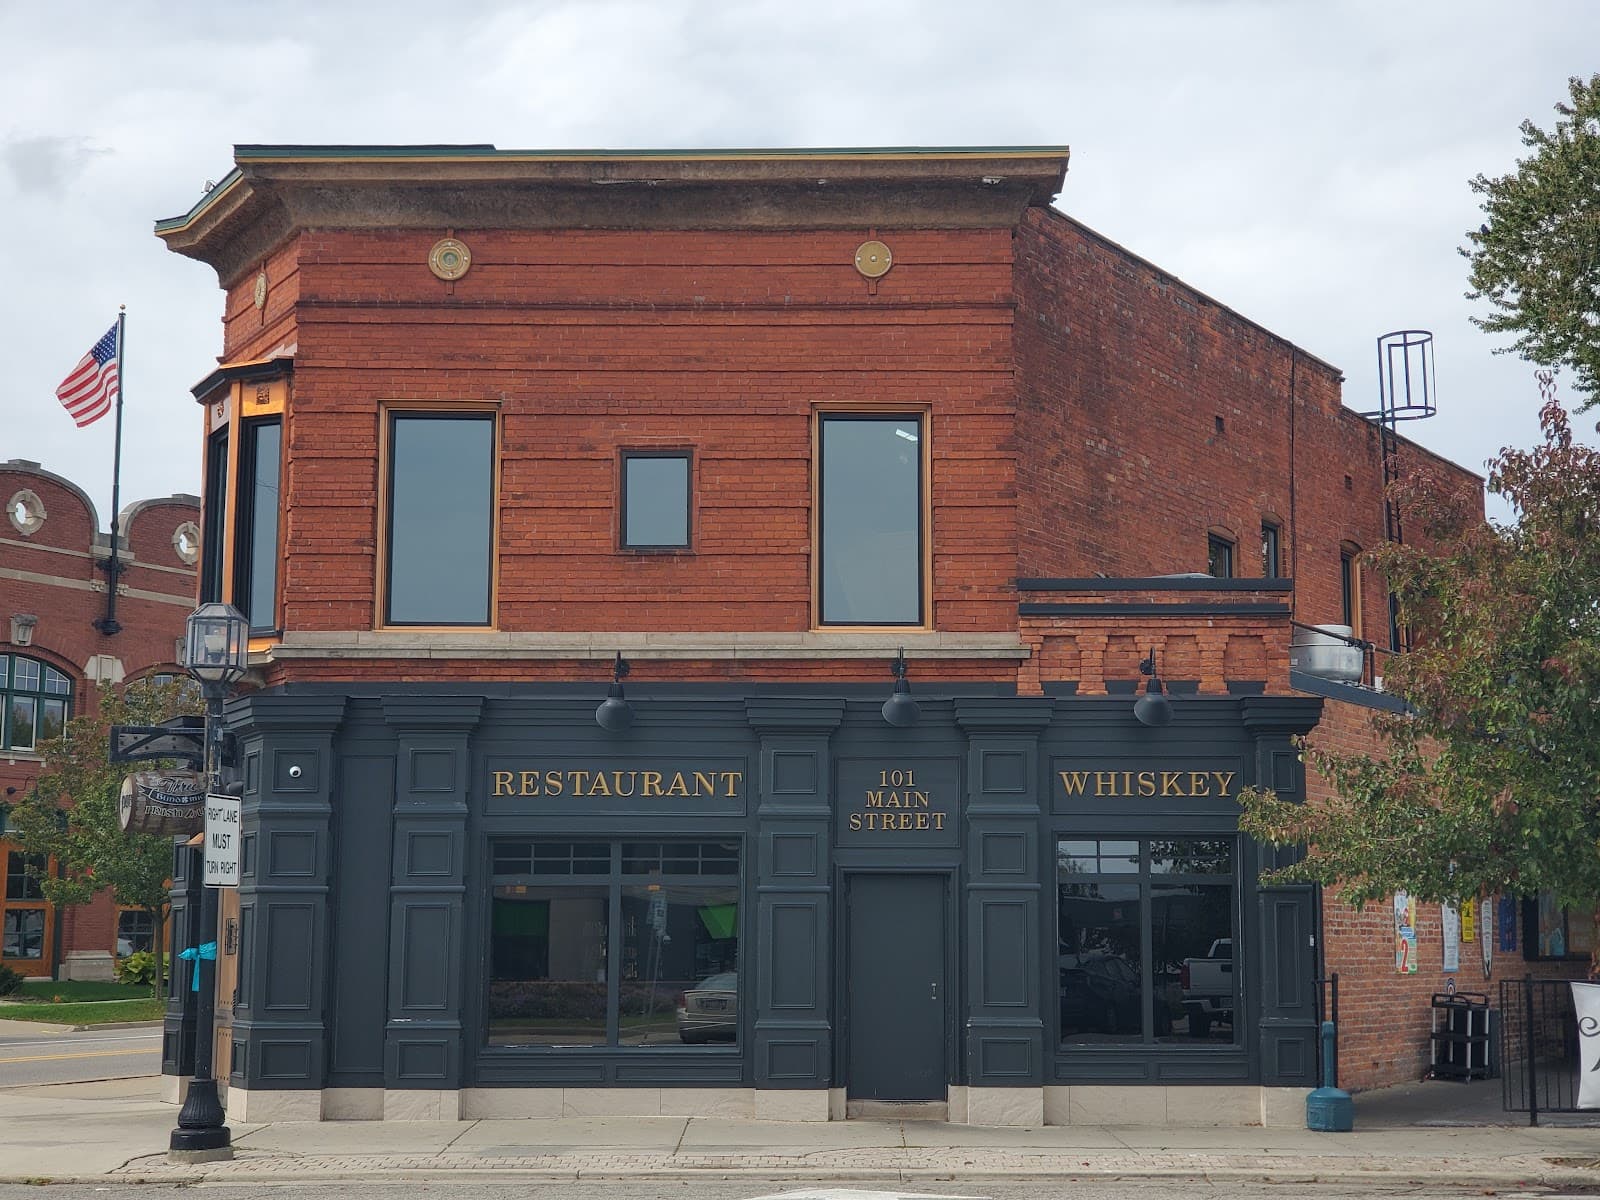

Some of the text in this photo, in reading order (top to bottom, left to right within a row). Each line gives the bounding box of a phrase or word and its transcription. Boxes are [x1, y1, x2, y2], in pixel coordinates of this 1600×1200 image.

[157, 777, 197, 793] Three
[491, 771, 743, 797] RESTAURANT
[879, 769, 917, 787] 101
[1058, 771, 1237, 797] WHISKEY
[865, 791, 930, 808] MAIN
[208, 807, 223, 821] RIGHT
[223, 809, 238, 824] LANE
[849, 812, 947, 831] STREET
[212, 833, 231, 850] MUST
[206, 860, 237, 875] TURN RIGHT
